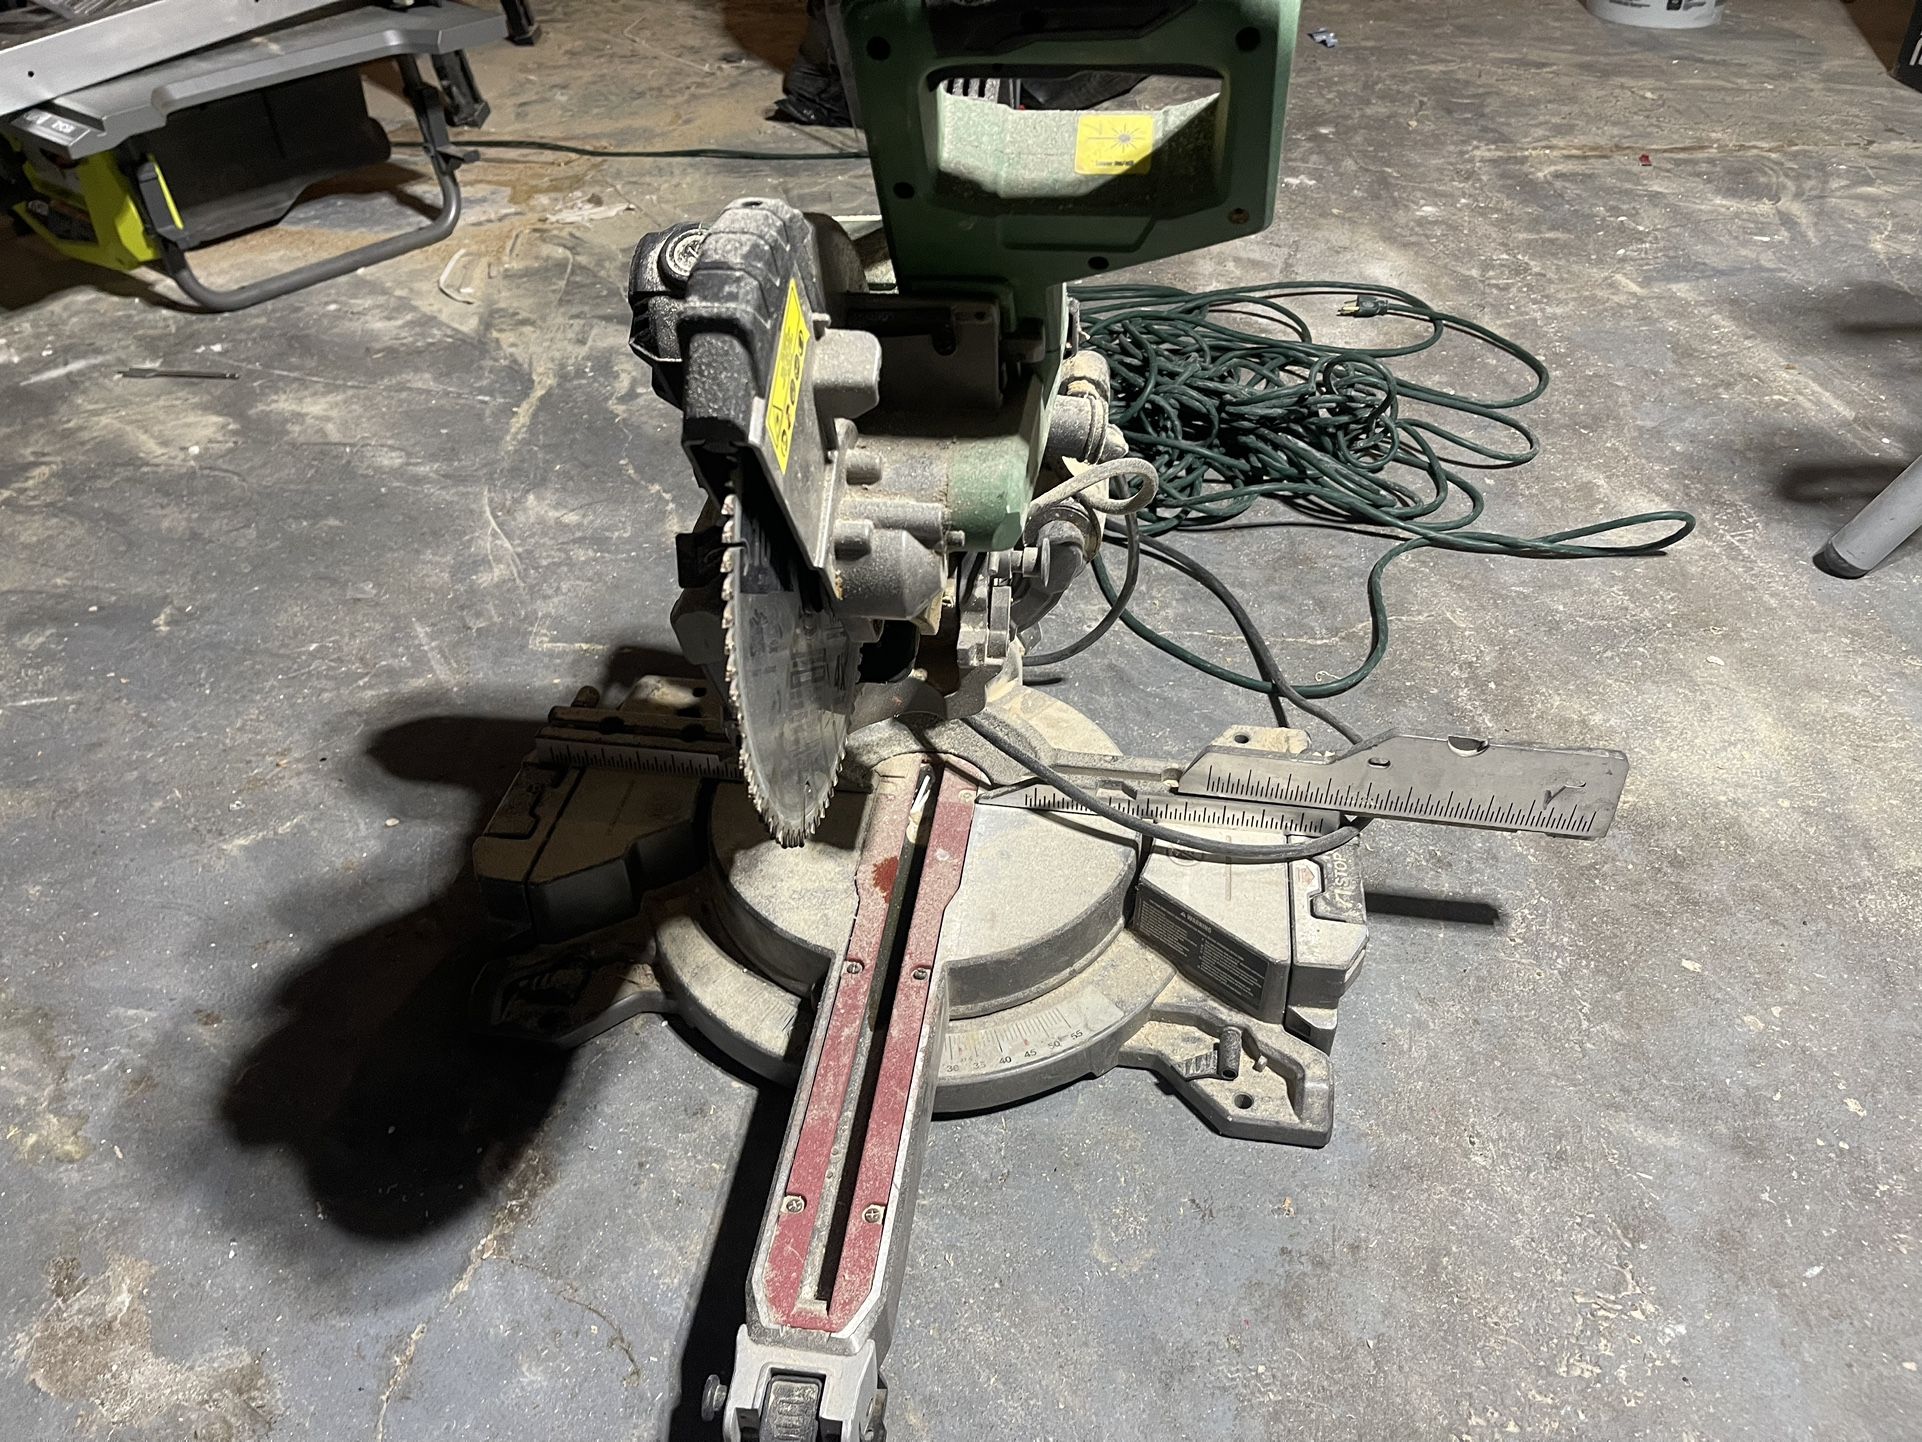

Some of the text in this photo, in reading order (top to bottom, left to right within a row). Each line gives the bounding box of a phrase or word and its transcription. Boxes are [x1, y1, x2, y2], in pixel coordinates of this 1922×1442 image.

[1333, 851, 1350, 888] STOP
[946, 1064, 960, 1073] 30
[999, 1055, 1012, 1064] 40
[1024, 1048, 1037, 1058] 45
[1047, 1040, 1061, 1050] 50
[1070, 1029, 1083, 1040] 55
